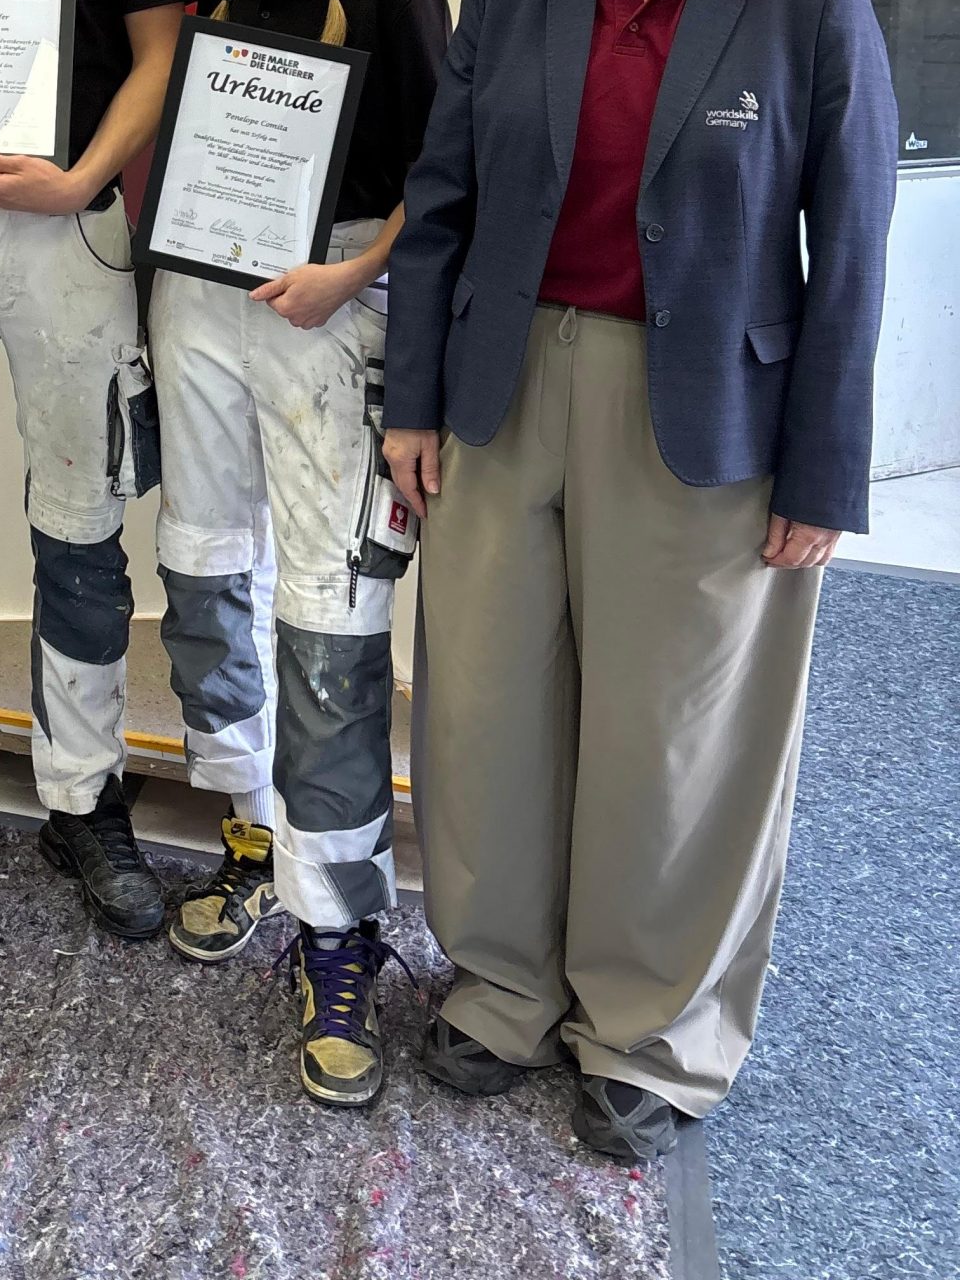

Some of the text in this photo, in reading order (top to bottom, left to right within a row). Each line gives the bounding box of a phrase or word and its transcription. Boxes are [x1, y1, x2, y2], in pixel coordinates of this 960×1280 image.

[251, 51, 299, 68] DIE MALER
[249, 59, 314, 80] DIE LACKIERER
[206, 71, 323, 113] Urkunde
[705, 117, 748, 130] Germany
[706, 109, 759, 121] worldskills
